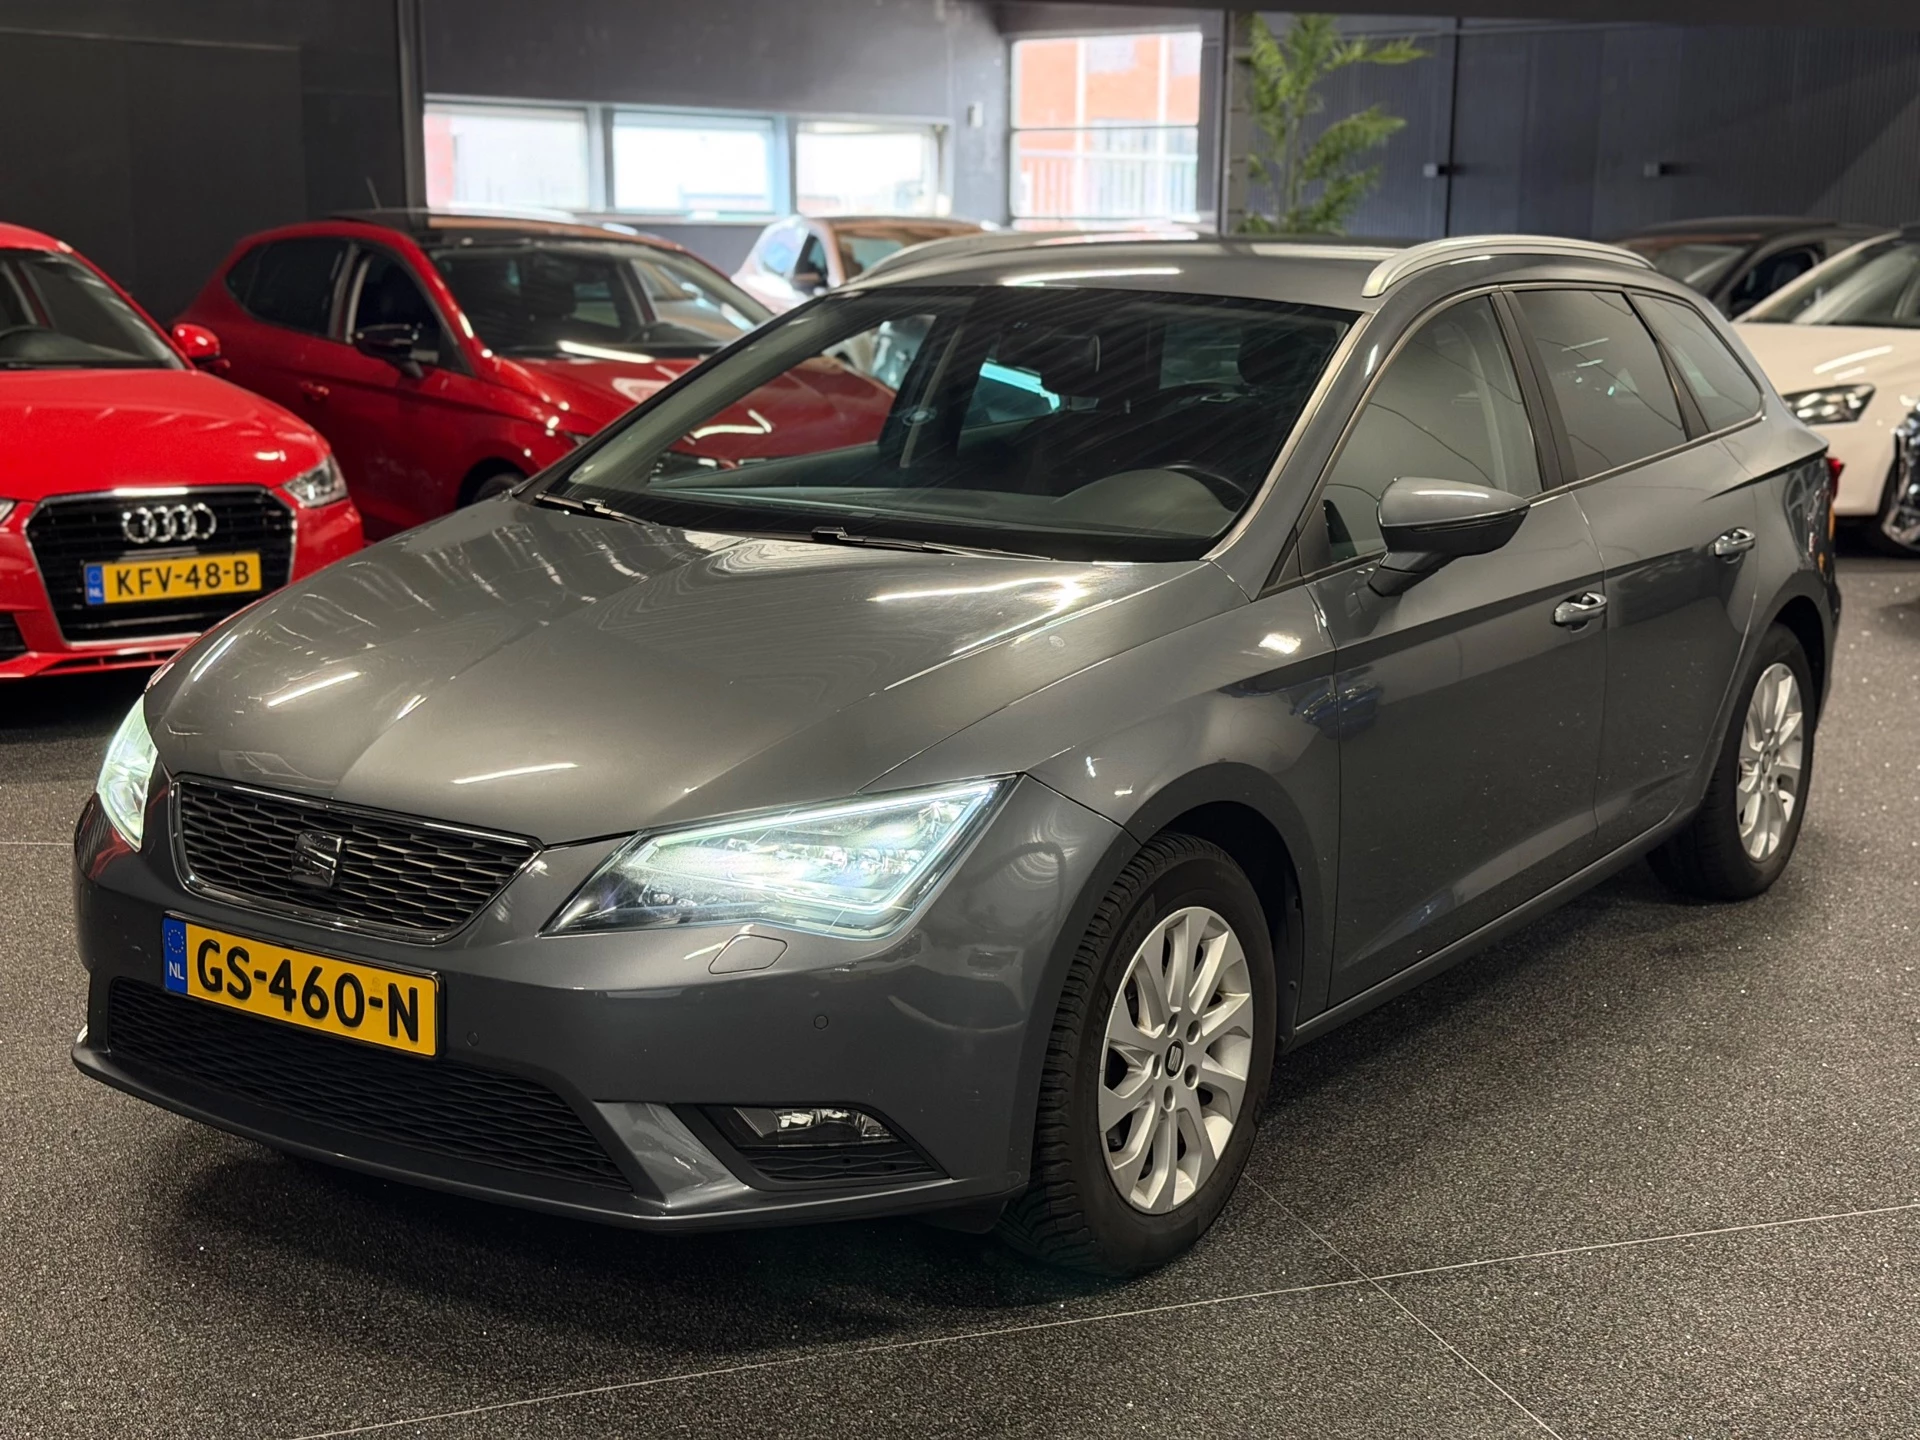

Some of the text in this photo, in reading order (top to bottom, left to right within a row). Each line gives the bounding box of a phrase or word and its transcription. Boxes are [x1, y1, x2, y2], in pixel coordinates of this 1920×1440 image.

[116, 560, 249, 596] KFV-48-B
[88, 588, 103, 597] NL
[168, 960, 185, 980] NL
[197, 939, 419, 1042] GS-460-N
